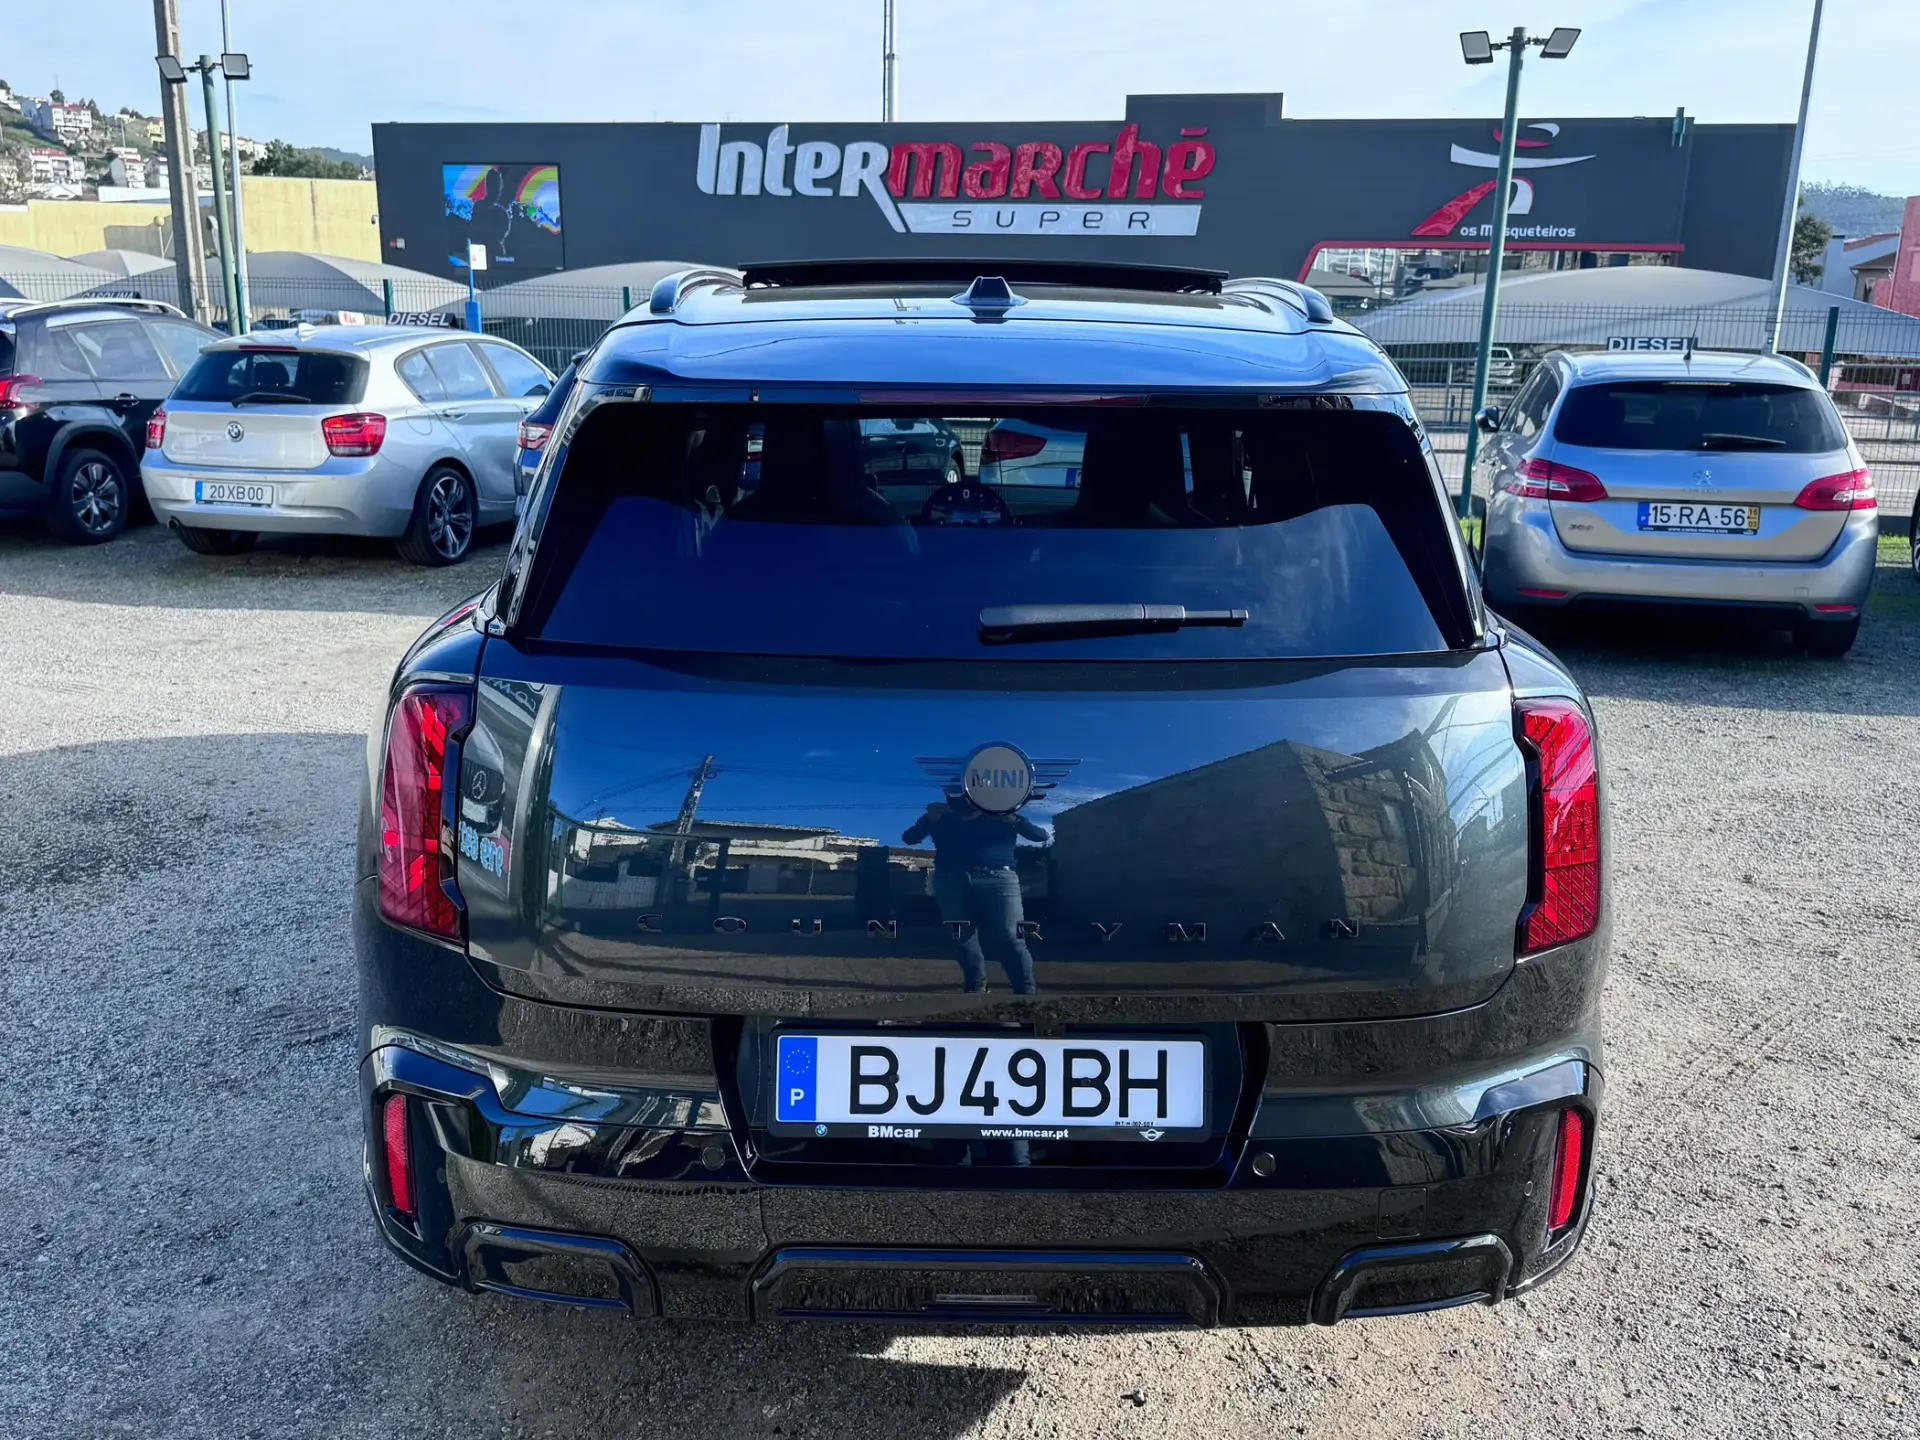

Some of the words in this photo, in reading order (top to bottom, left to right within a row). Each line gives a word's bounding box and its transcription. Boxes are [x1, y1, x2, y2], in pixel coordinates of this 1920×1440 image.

[1459, 226, 1477, 237] os
[1480, 224, 1576, 240] Msqueteiros
[387, 312, 450, 327] DIESEL
[970, 767, 1025, 789] MINI
[636, 912, 1361, 943] COUNTRYMAN
[790, 1088, 805, 1107] P
[849, 1045, 1168, 1118] BJ49BH
[868, 1125, 922, 1138] BMcar
[980, 1127, 1069, 1140] www.bmcar.pt
